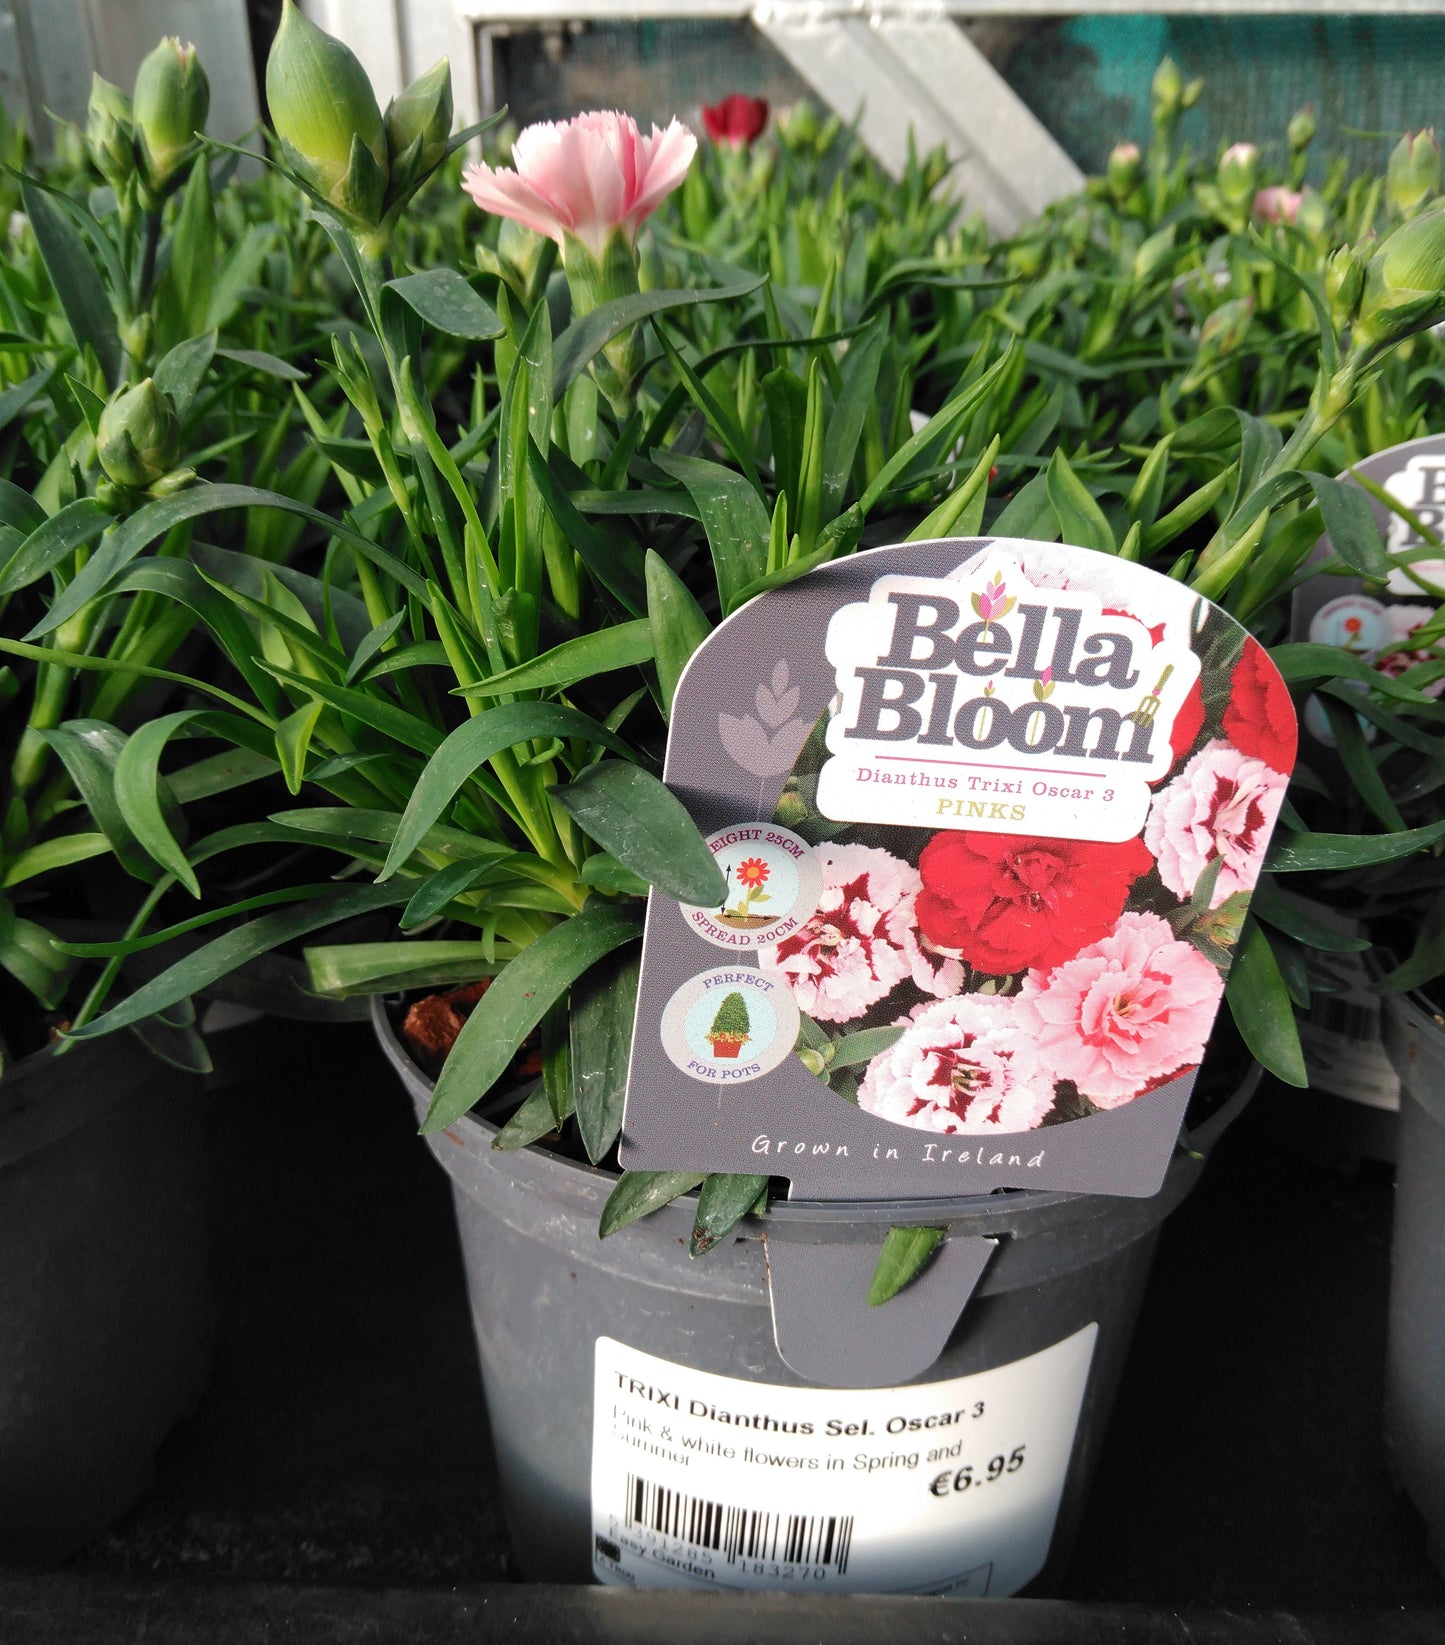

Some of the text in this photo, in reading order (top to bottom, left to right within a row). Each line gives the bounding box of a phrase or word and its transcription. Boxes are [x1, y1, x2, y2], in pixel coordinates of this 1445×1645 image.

[877, 592, 1140, 690] Bella
[844, 666, 1155, 764] Bloom
[856, 767, 1115, 802] Dianthus Trixi Oscar 3
[936, 798, 1027, 821] PINKS
[710, 829, 805, 859] EIGHT 25CM
[691, 911, 799, 946] SPREAD 20CM
[702, 973, 775, 992] PERFECT
[687, 1060, 762, 1079] FOR POTS
[751, 1134, 1045, 1168] Grown in Ireland
[614, 1370, 985, 1437] TRIXI Dianthus Sel. Oscar 3
[613, 1404, 963, 1474] Pink & white flowers in Spring and
[613, 1423, 690, 1466] Summer
[929, 1444, 1026, 1497] €6.95
[652, 1547, 715, 1579] Garden
[740, 1561, 826, 1580] 183270
